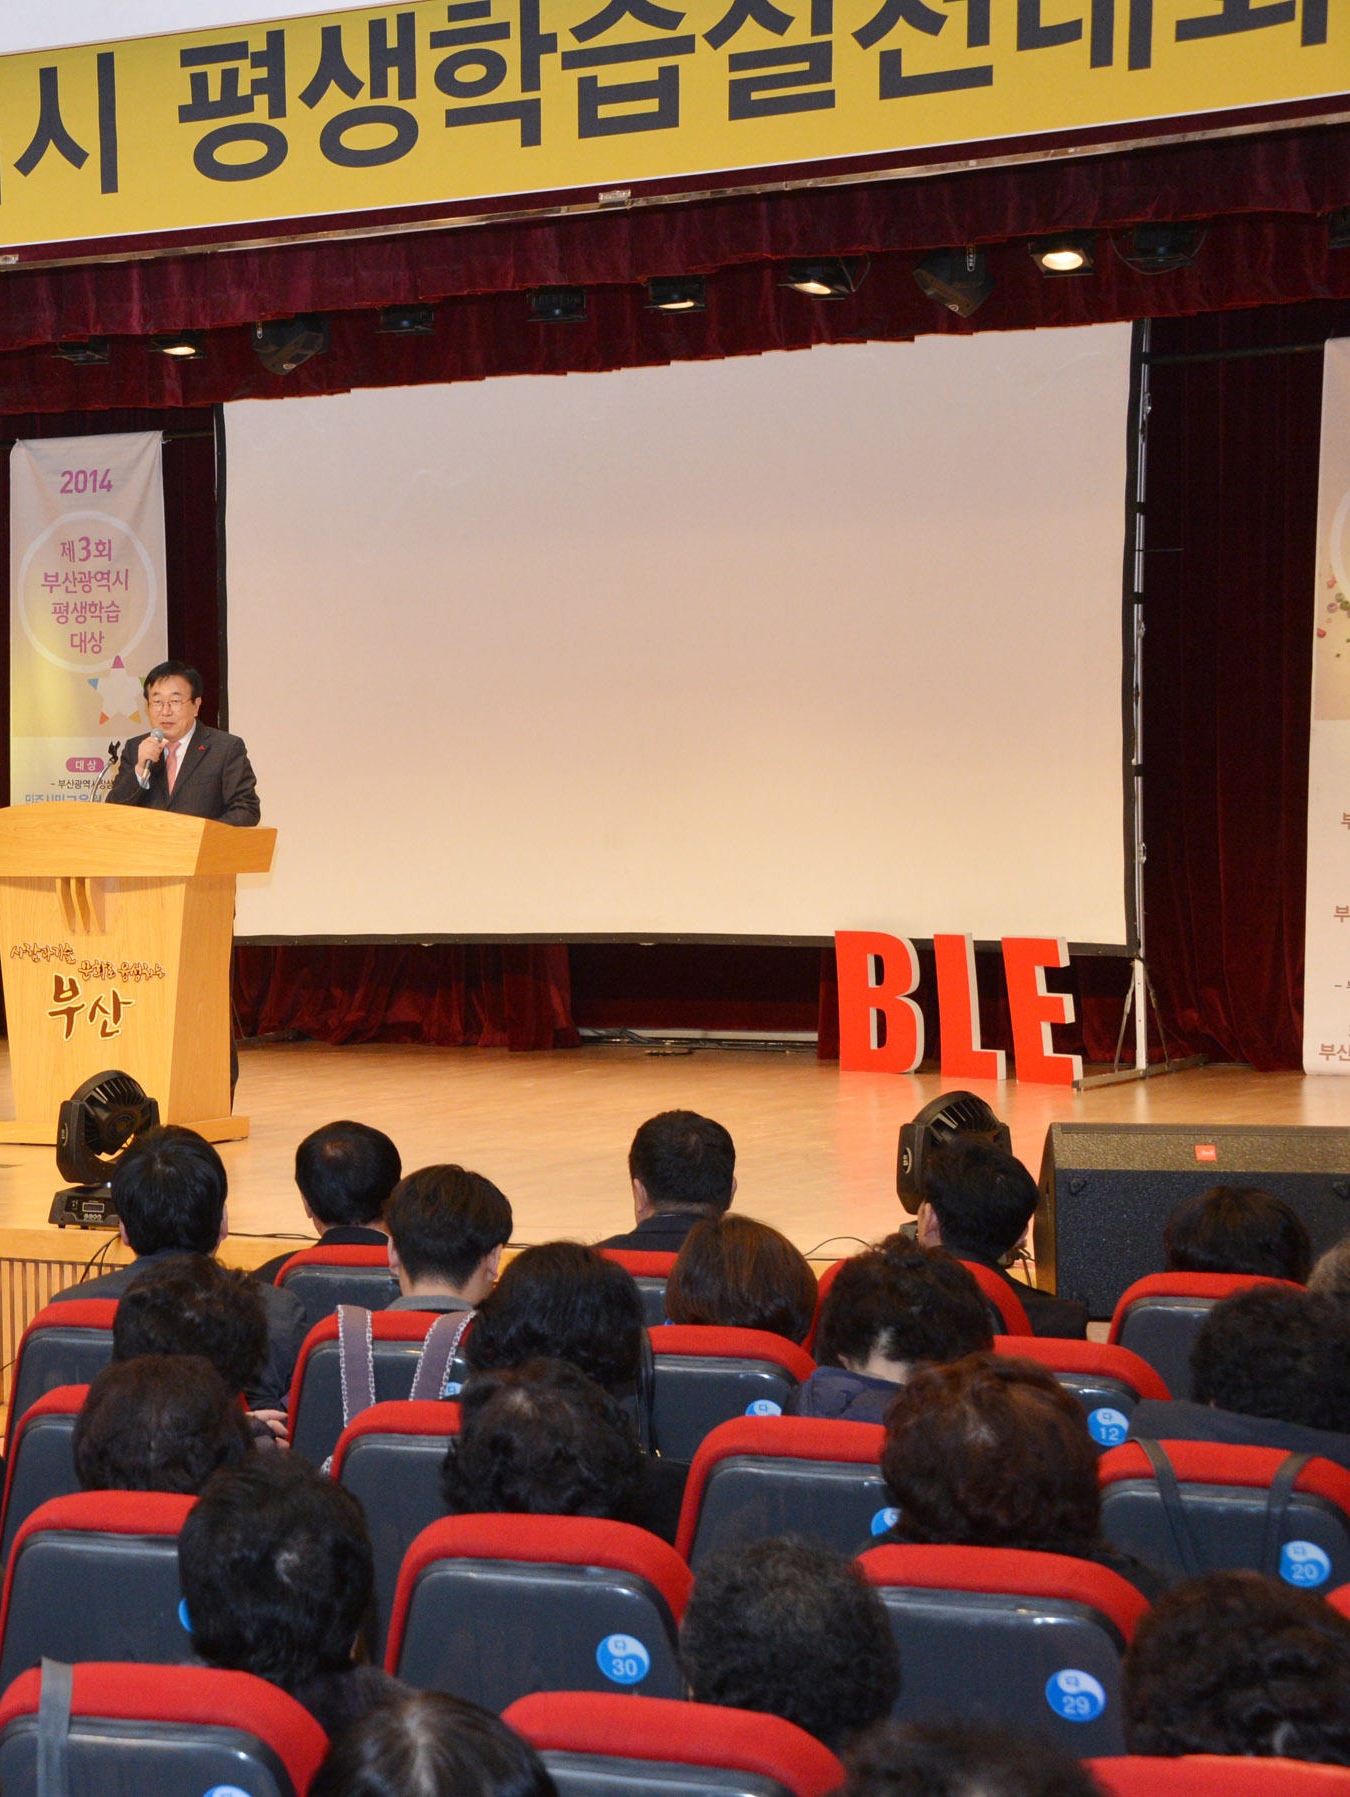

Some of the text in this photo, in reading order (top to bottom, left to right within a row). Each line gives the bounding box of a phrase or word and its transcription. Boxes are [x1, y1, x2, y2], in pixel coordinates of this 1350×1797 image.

[59, 468, 113, 494] 2014
[60, 536, 112, 563] 제3회
[41, 568, 130, 594] 부산광역시
[51, 600, 121, 625] 평생학습
[70, 630, 105, 655] 대상
[47, 973, 135, 1041] 부산
[1100, 1427, 1120, 1441] 12
[1291, 1563, 1318, 1580] 20
[612, 1658, 637, 1677] 30
[1062, 1696, 1091, 1715] 29
